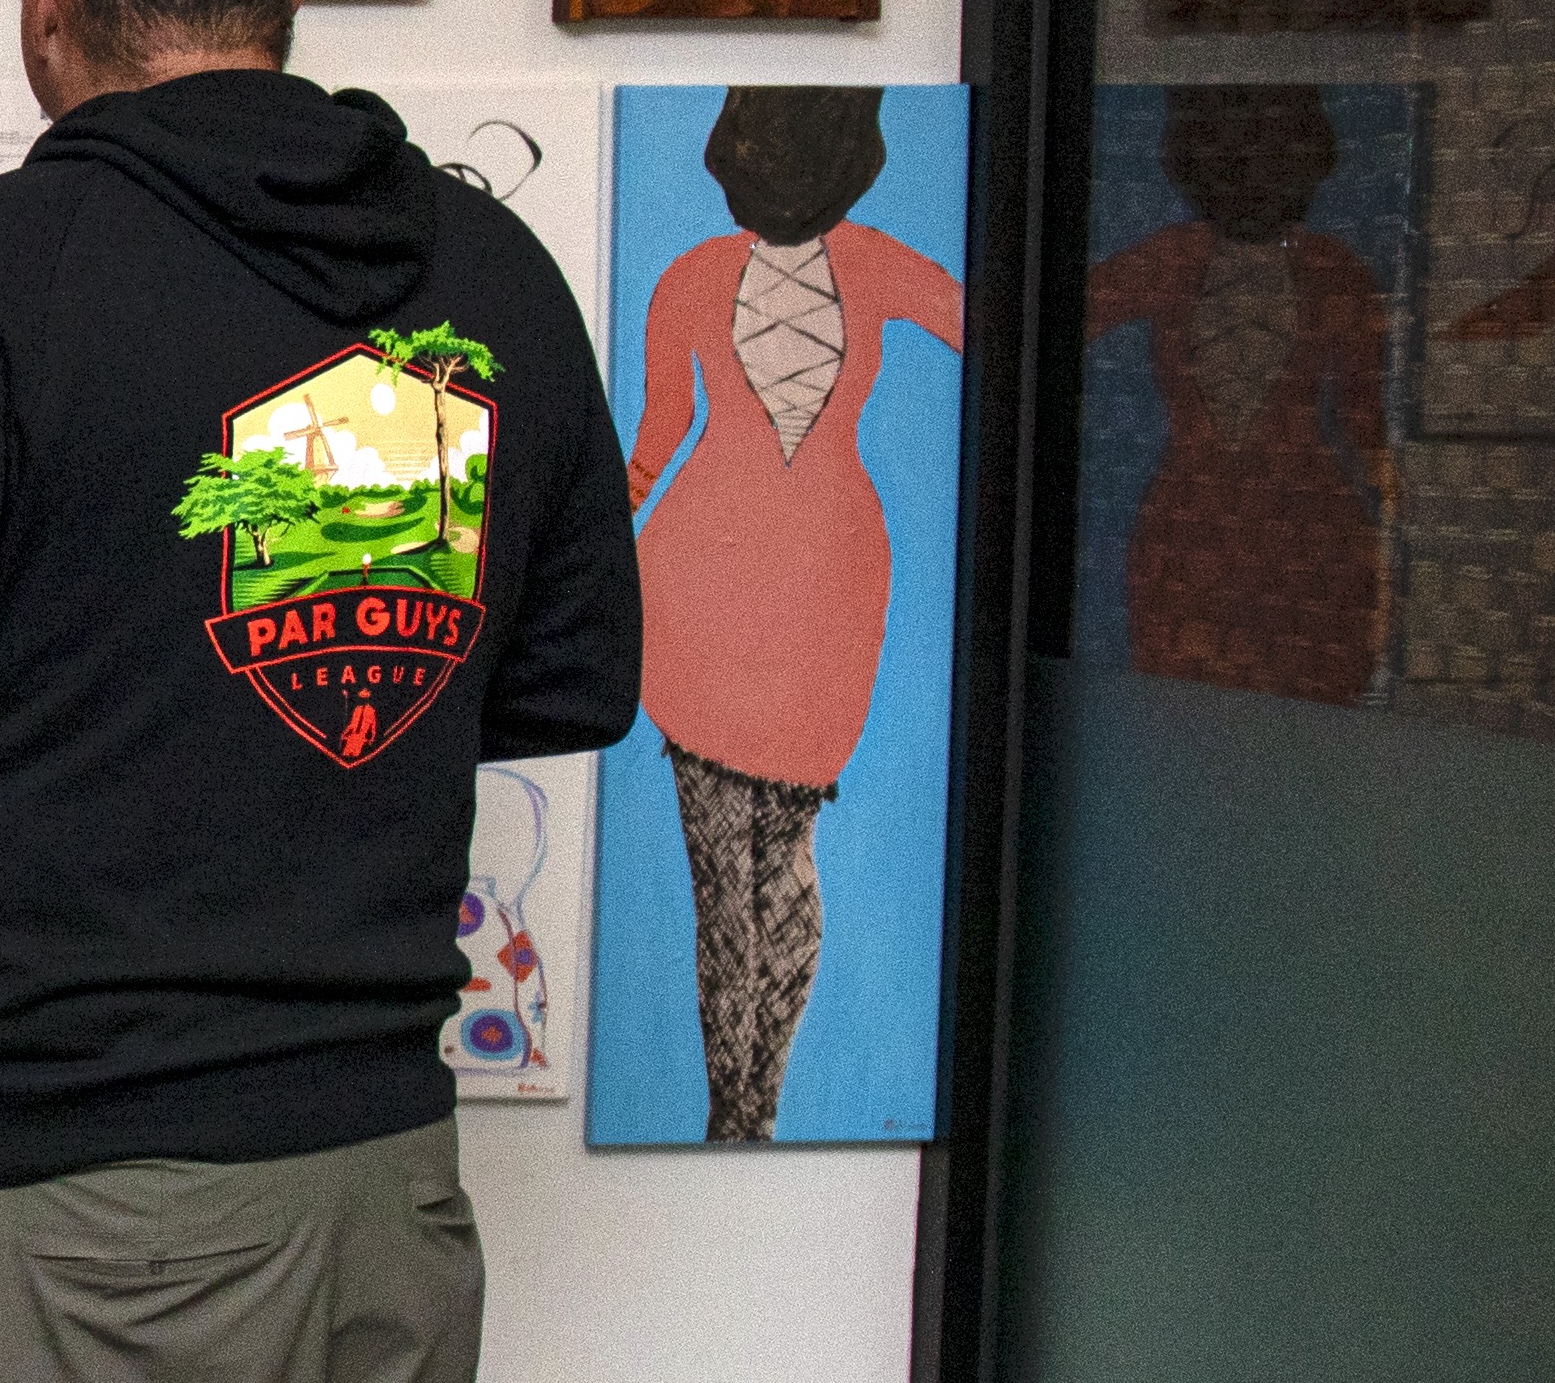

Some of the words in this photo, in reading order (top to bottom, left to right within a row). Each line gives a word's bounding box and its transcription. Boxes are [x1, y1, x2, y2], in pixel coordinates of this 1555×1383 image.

[246, 600, 337, 658] PAR
[355, 595, 463, 647] GUYS
[291, 663, 427, 692] LEAGUE
